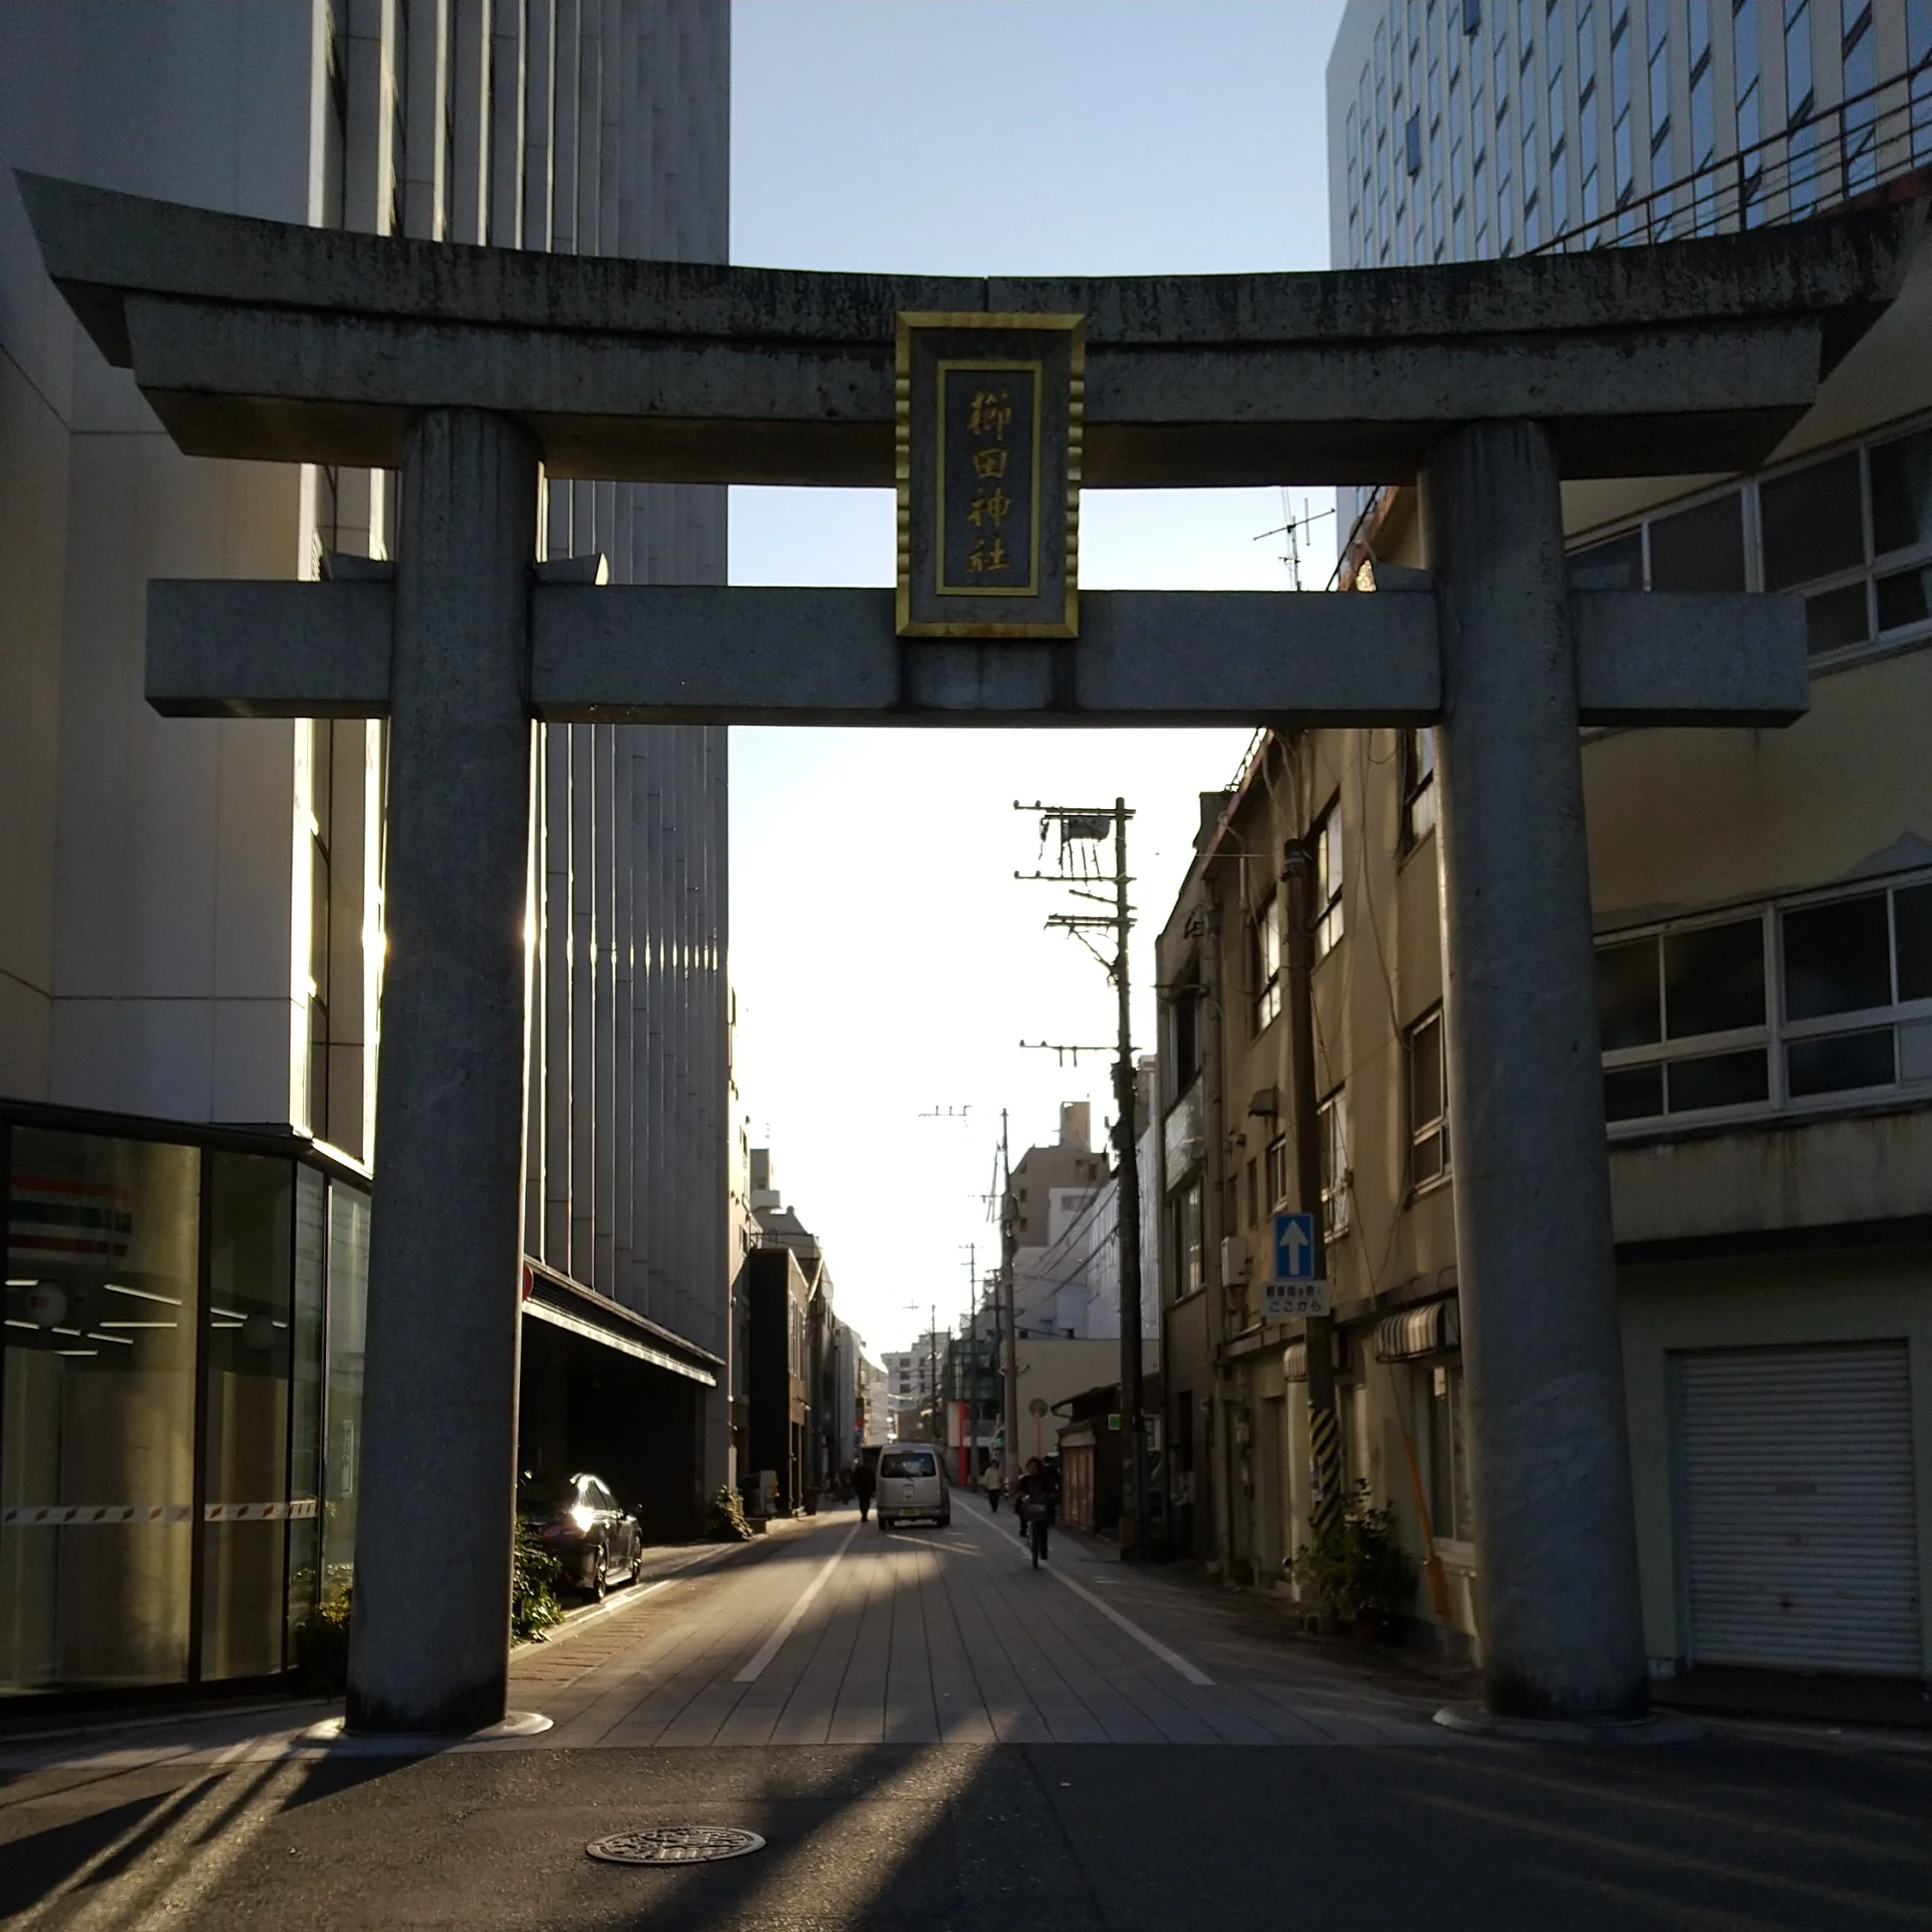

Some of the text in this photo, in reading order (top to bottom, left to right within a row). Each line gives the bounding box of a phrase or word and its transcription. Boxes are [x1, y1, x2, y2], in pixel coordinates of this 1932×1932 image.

[967, 390, 1012, 573] 櫛田神社
[1269, 1301, 1321, 1312] ここから
